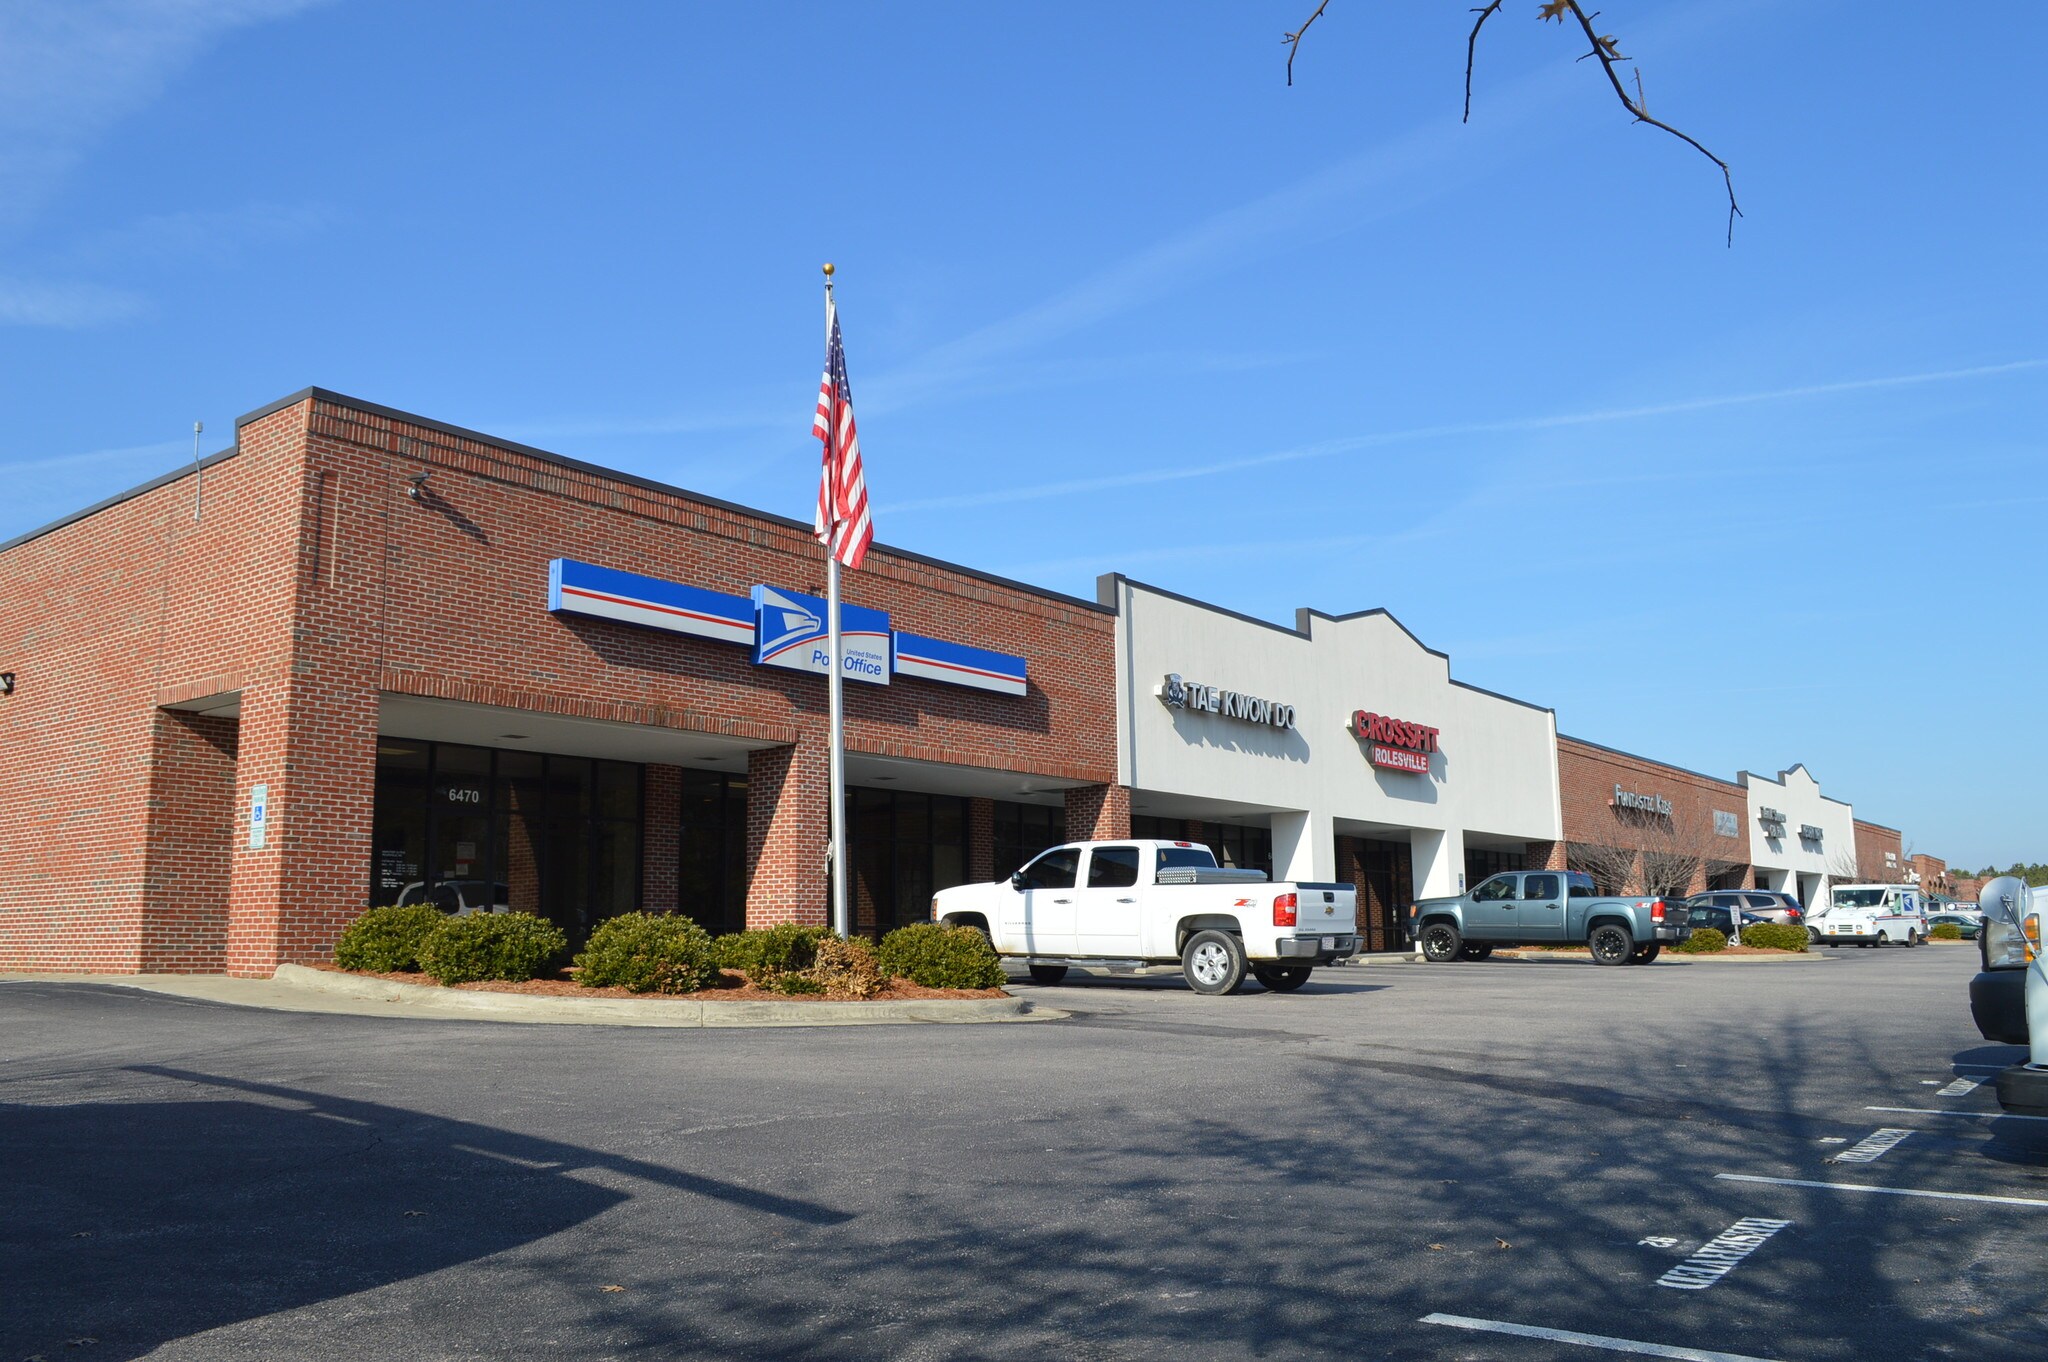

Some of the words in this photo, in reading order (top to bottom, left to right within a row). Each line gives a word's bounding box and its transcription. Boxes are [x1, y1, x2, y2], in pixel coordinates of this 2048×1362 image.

[847, 649, 864, 657] United
[865, 652, 882, 660] States
[844, 656, 881, 675] Office
[1184, 682, 1219, 712] TAE
[1220, 690, 1271, 724] KWON
[1272, 702, 1297, 729] DO
[1352, 710, 1440, 753] CROSSFIT
[1375, 747, 1427, 771] ROLESVILLE
[449, 789, 479, 803] 6470
